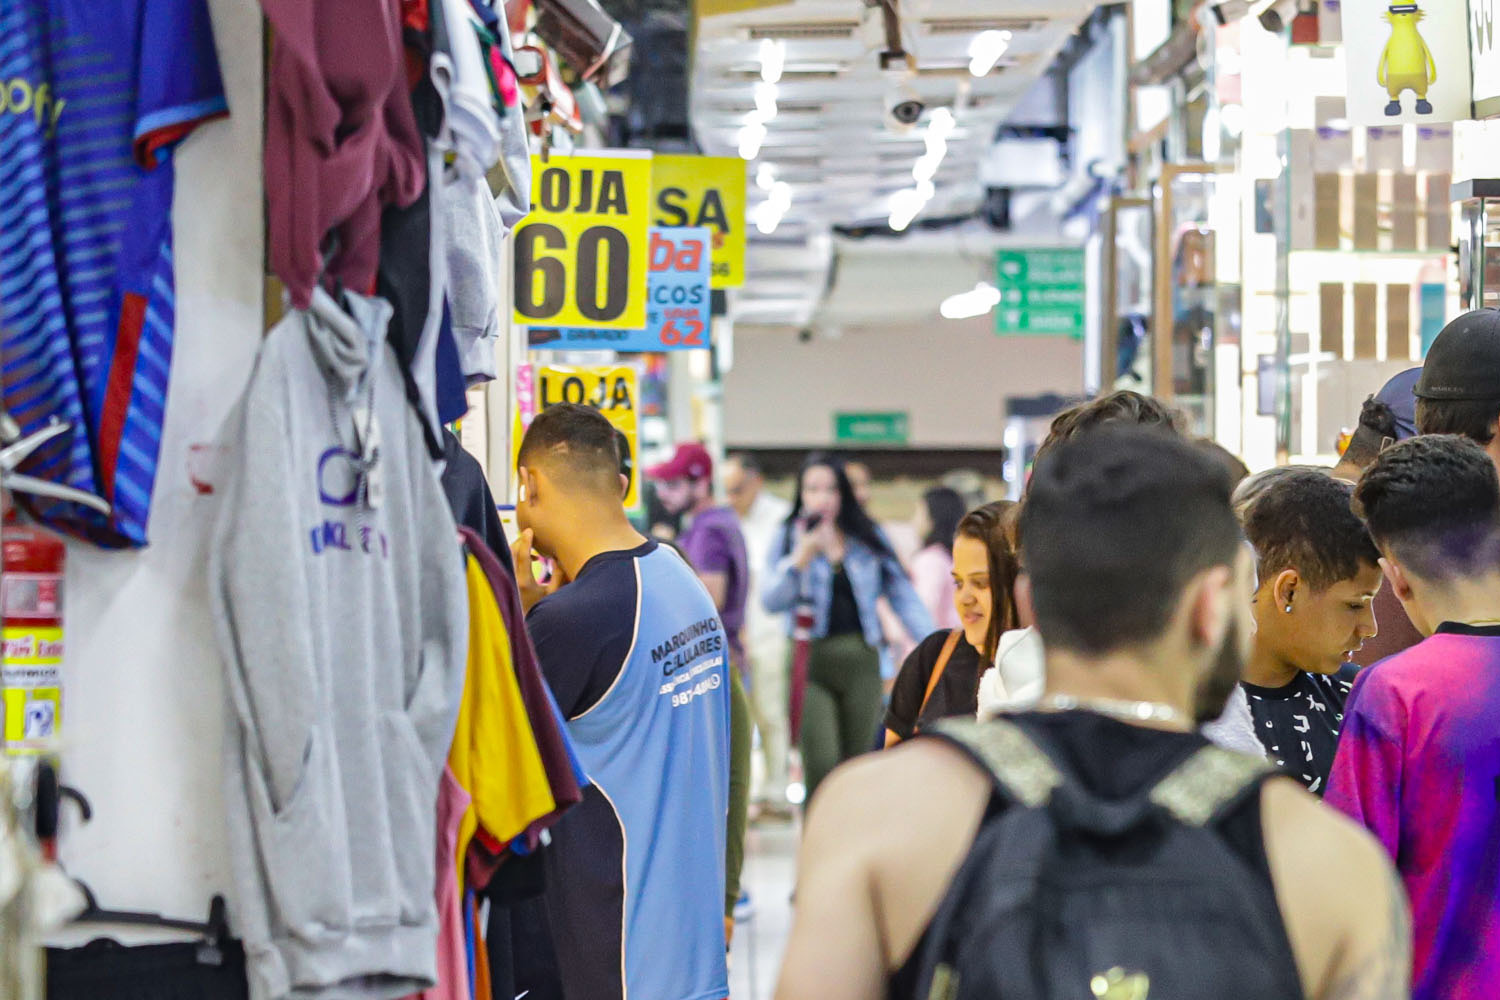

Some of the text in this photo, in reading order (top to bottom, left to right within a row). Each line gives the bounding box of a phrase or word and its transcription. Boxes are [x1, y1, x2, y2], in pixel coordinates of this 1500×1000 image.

[530, 167, 628, 215] OJA
[514, 223, 630, 322] 60
[659, 319, 704, 346] 62
[541, 376, 633, 411] LOJA
[663, 635, 722, 677] CLULARES
